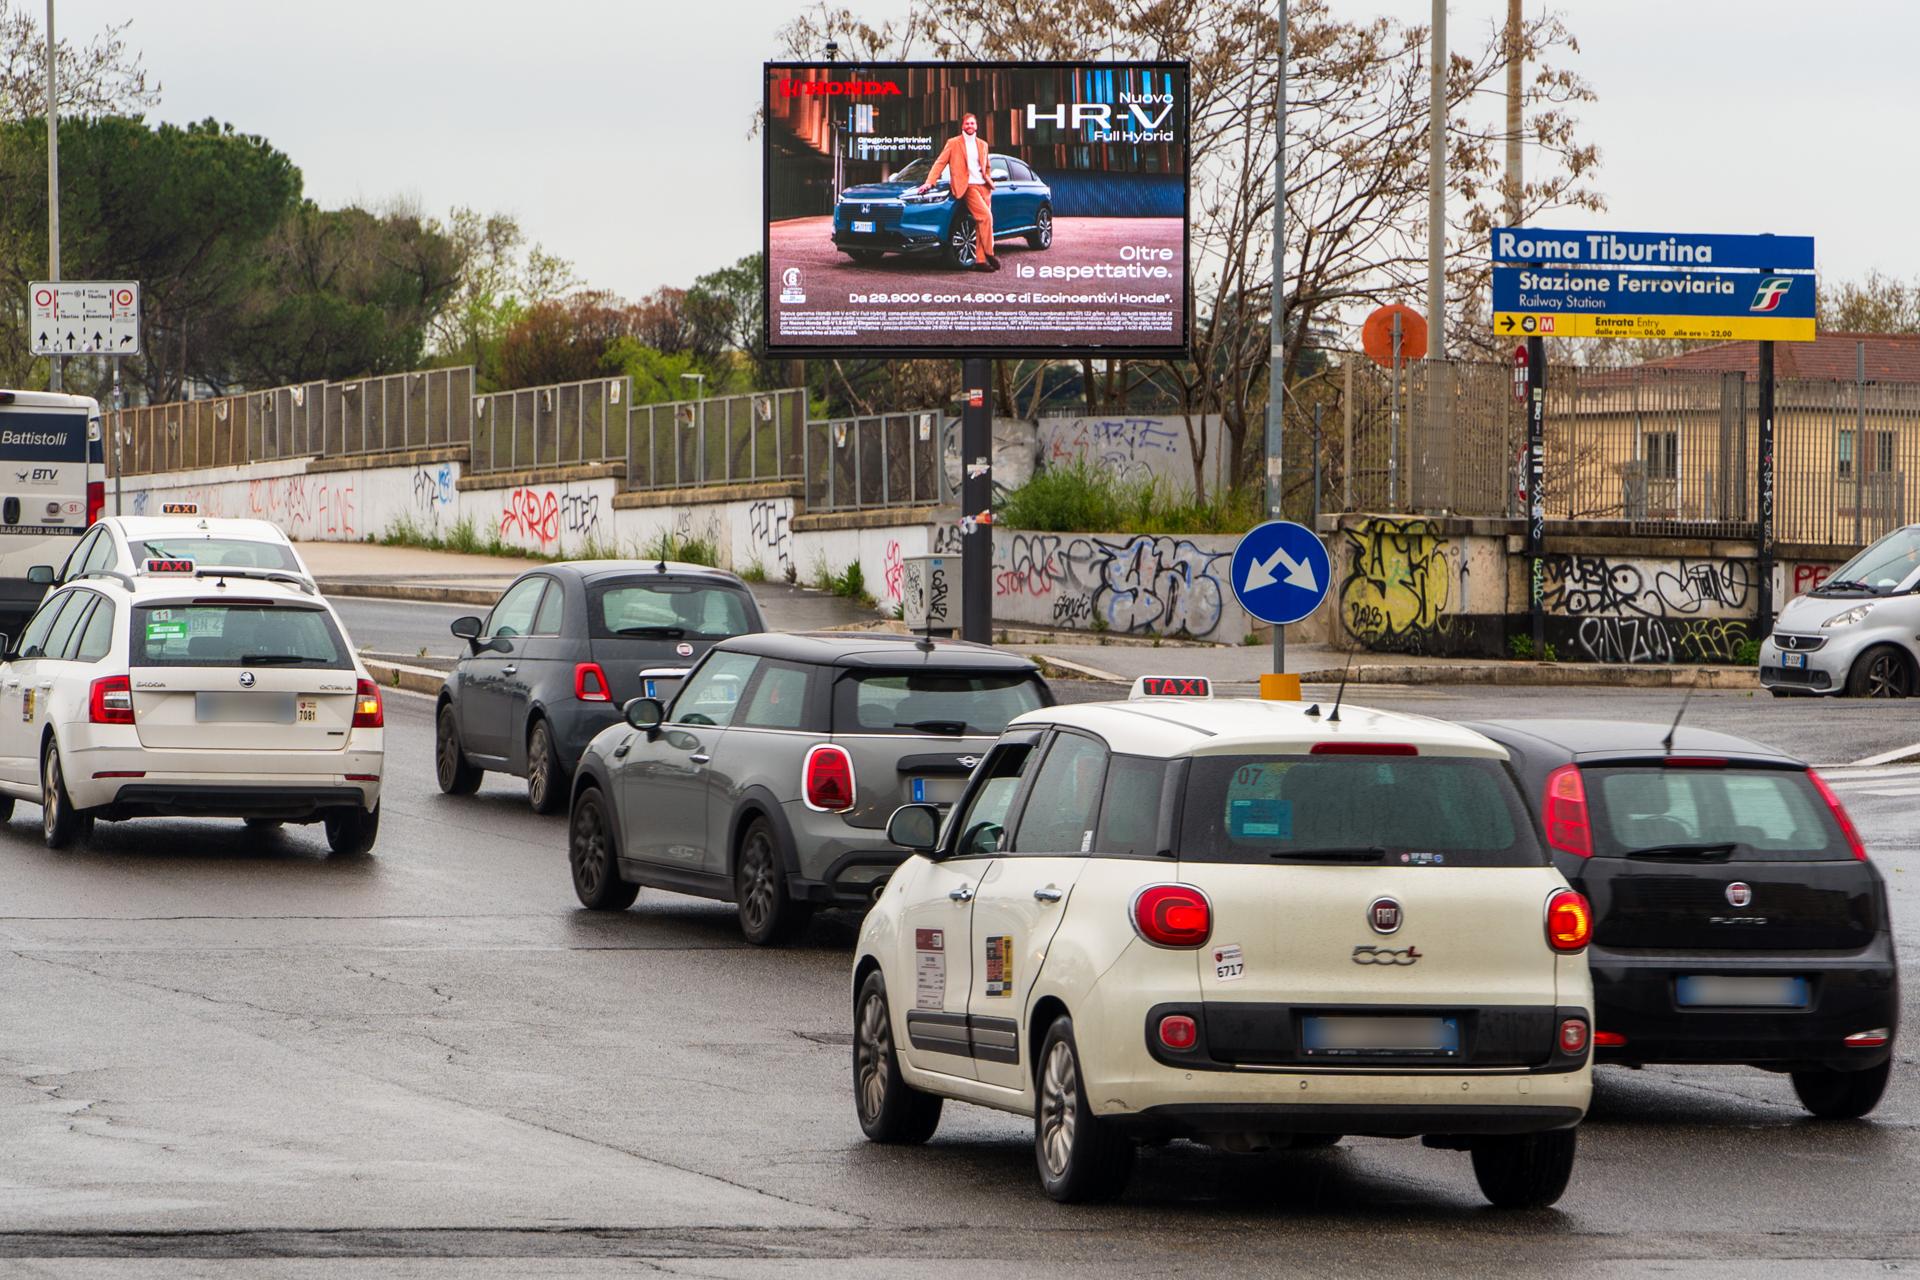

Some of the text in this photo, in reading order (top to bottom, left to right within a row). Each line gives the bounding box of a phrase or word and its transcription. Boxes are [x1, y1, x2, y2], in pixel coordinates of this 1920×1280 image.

[805, 81, 902, 95] HONDA
[1119, 92, 1174, 104] Nuovo
[1026, 103, 1174, 129] HR-V
[1094, 130, 1174, 144] Full Hybrid
[1119, 245, 1174, 261] Oltre
[1499, 232, 1713, 263] Roma Tiburtina
[1016, 262, 1174, 282] le aspettative.
[1519, 271, 1735, 295] Stazione Ferroviaria
[848, 293, 868, 304] Da
[920, 293, 933, 304] €
[962, 293, 1005, 304] 4.600
[1005, 293, 1017, 304] €
[1018, 292, 1031, 304] di
[1519, 293, 1606, 310] Railway Station
[1541, 318, 1554, 331] M
[1595, 317, 1660, 329] Entrata Entry
[1, 431, 67, 446] Battistolli
[32, 469, 58, 480] BTV
[164, 505, 197, 513] TAXI
[45, 527, 73, 535] VALORI
[149, 560, 191, 571] TAXI
[156, 610, 169, 619] 11
[1145, 679, 1205, 695] TAXI
[299, 710, 316, 720] 7081
[1238, 767, 1264, 785] 07
[1217, 963, 1244, 978] 6717
